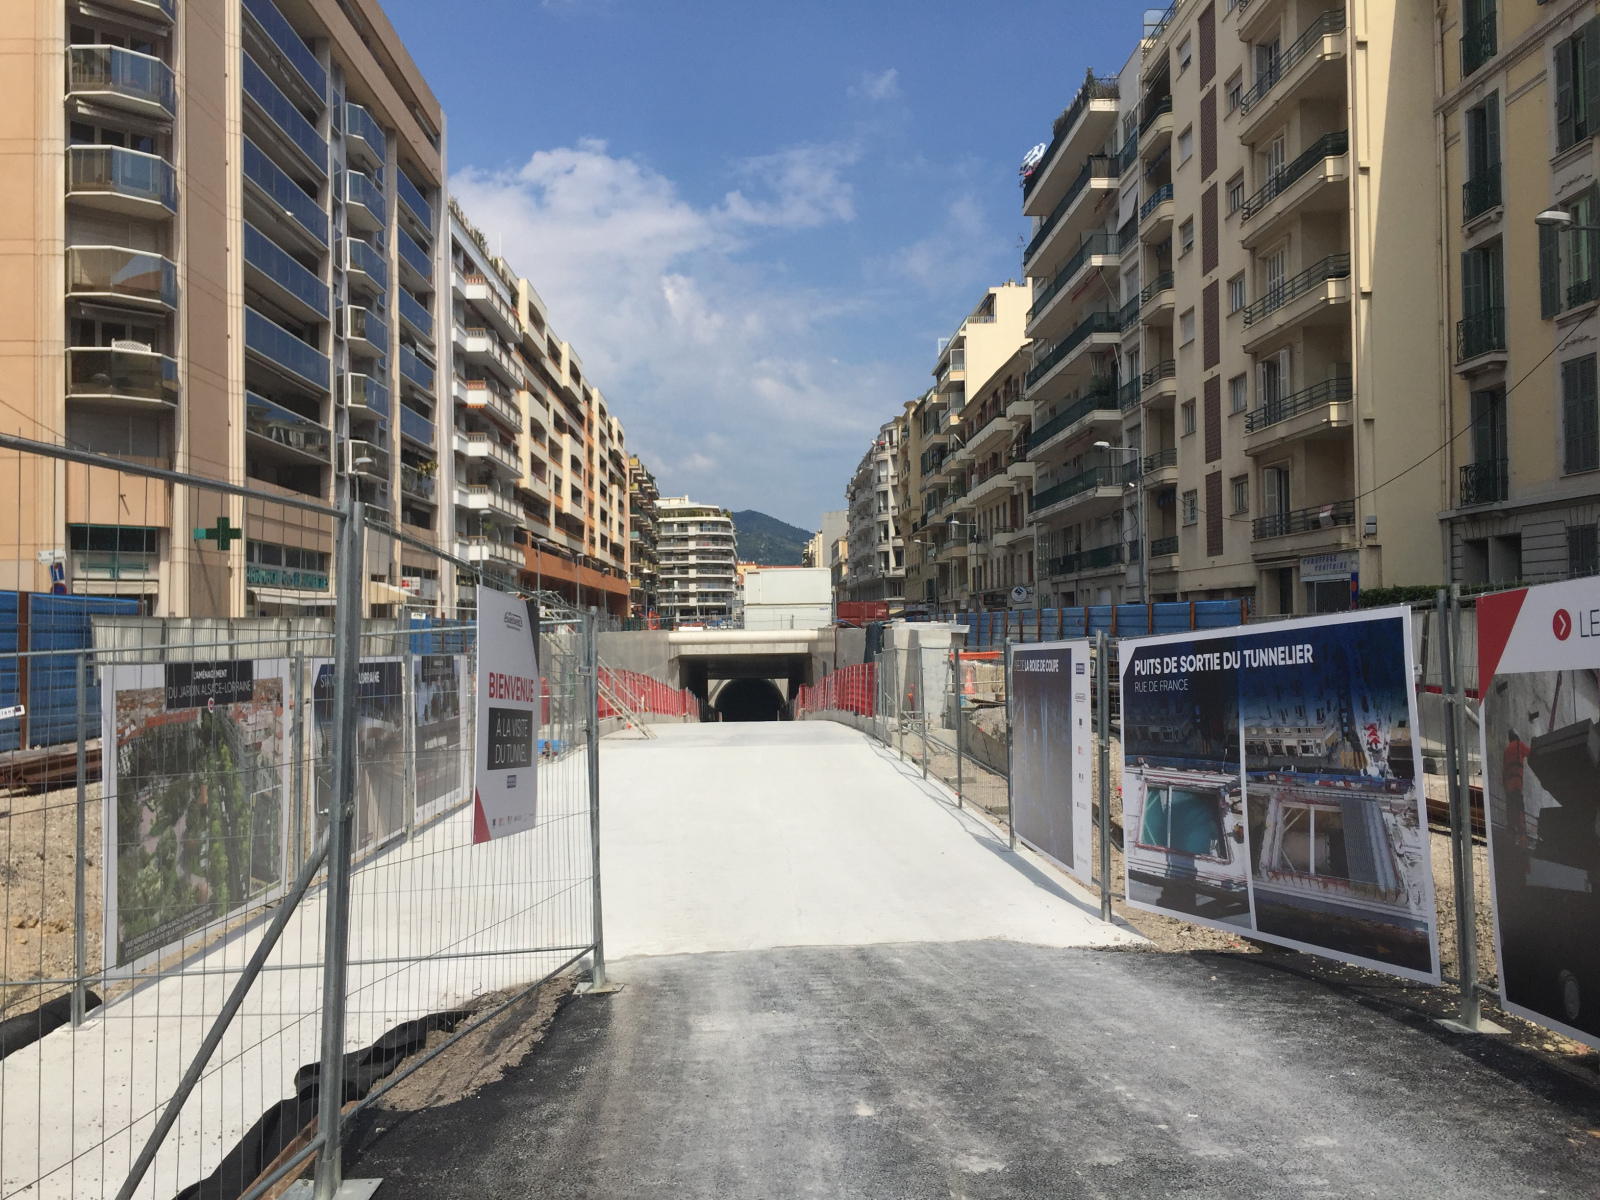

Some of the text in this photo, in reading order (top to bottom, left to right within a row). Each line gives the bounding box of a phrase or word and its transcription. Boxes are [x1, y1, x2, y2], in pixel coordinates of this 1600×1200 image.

[1030, 659, 1039, 672] ROUE
[1040, 659, 1045, 672] DE
[1046, 659, 1059, 672] COUPE
[1134, 644, 1313, 676] PUITS DE SORTIE DU TUNNELIER
[168, 680, 251, 699] DU JARDIN ALSACE-LORRAINE
[489, 672, 534, 702] BIENVENUE
[1134, 679, 1188, 693] RUE DE FRANCE
[496, 712, 528, 737] À LA VISITE
[495, 744, 527, 763] DU TUNNEL
